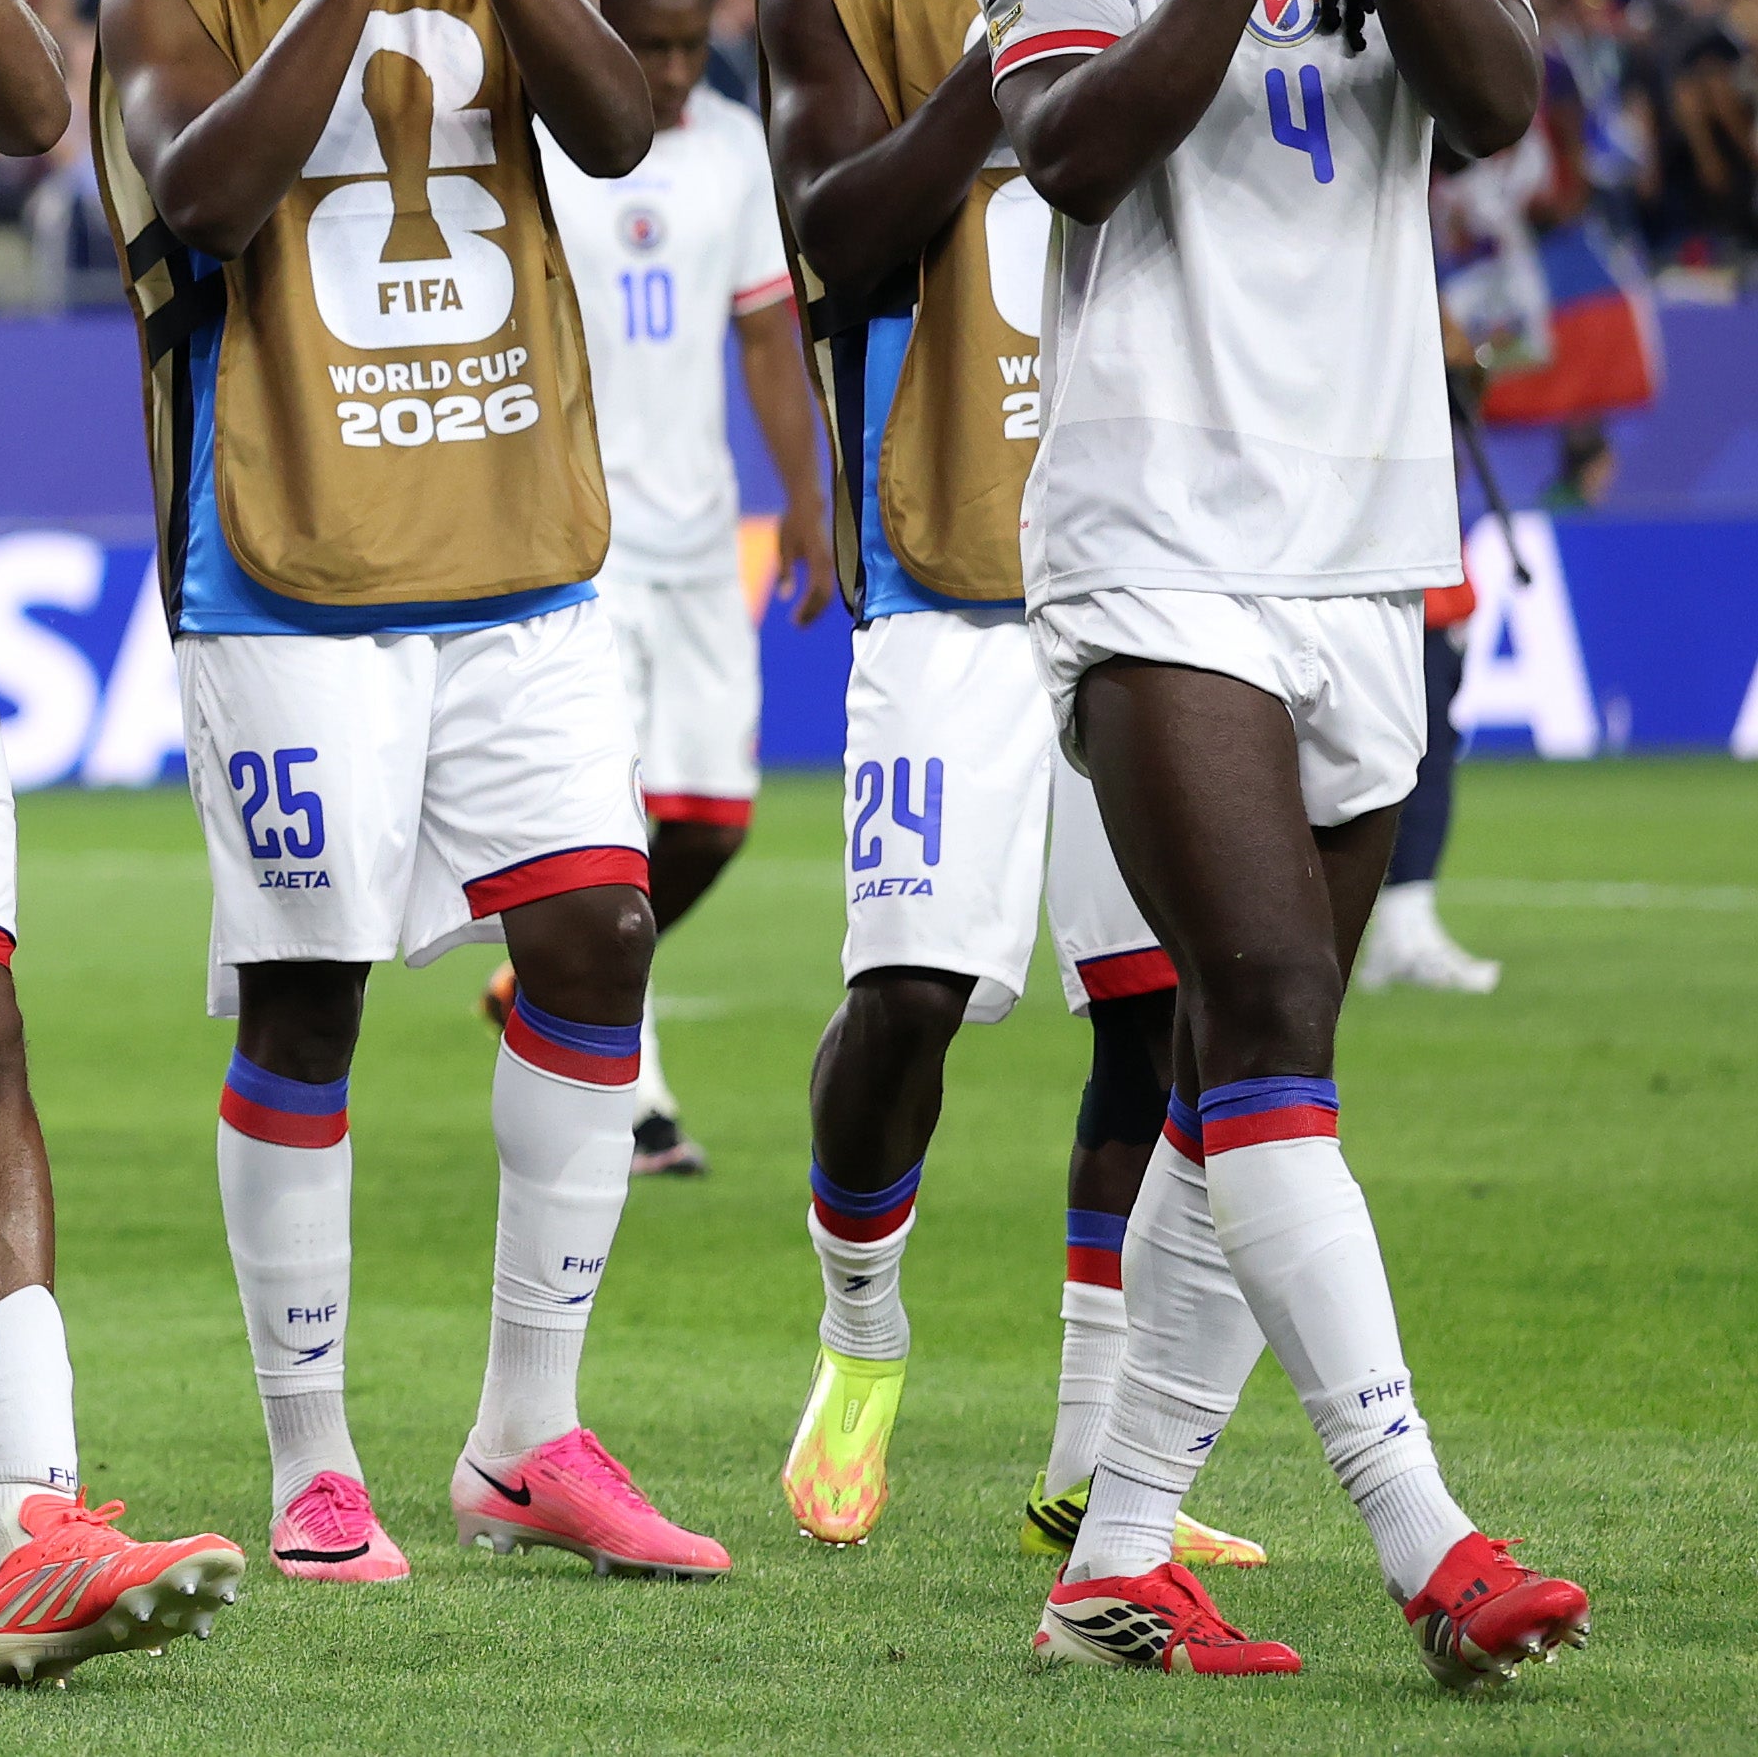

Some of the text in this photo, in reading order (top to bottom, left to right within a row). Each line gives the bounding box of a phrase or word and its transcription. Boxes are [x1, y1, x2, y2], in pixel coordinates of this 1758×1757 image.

[1265, 65, 1334, 184] 4
[378, 277, 464, 315] FIFA
[617, 266, 675, 342] 10
[328, 347, 529, 395] WORLD CUP
[336, 383, 540, 449] 2026
[229, 747, 325, 860] 25
[852, 757, 944, 873] 24
[259, 870, 331, 889] SAETA
[852, 877, 934, 903] SAETA
[562, 1255, 606, 1274] FHF
[287, 1302, 337, 1324] FHF
[1358, 1379, 1407, 1410] FHF
[49, 1466, 77, 1487] FH
